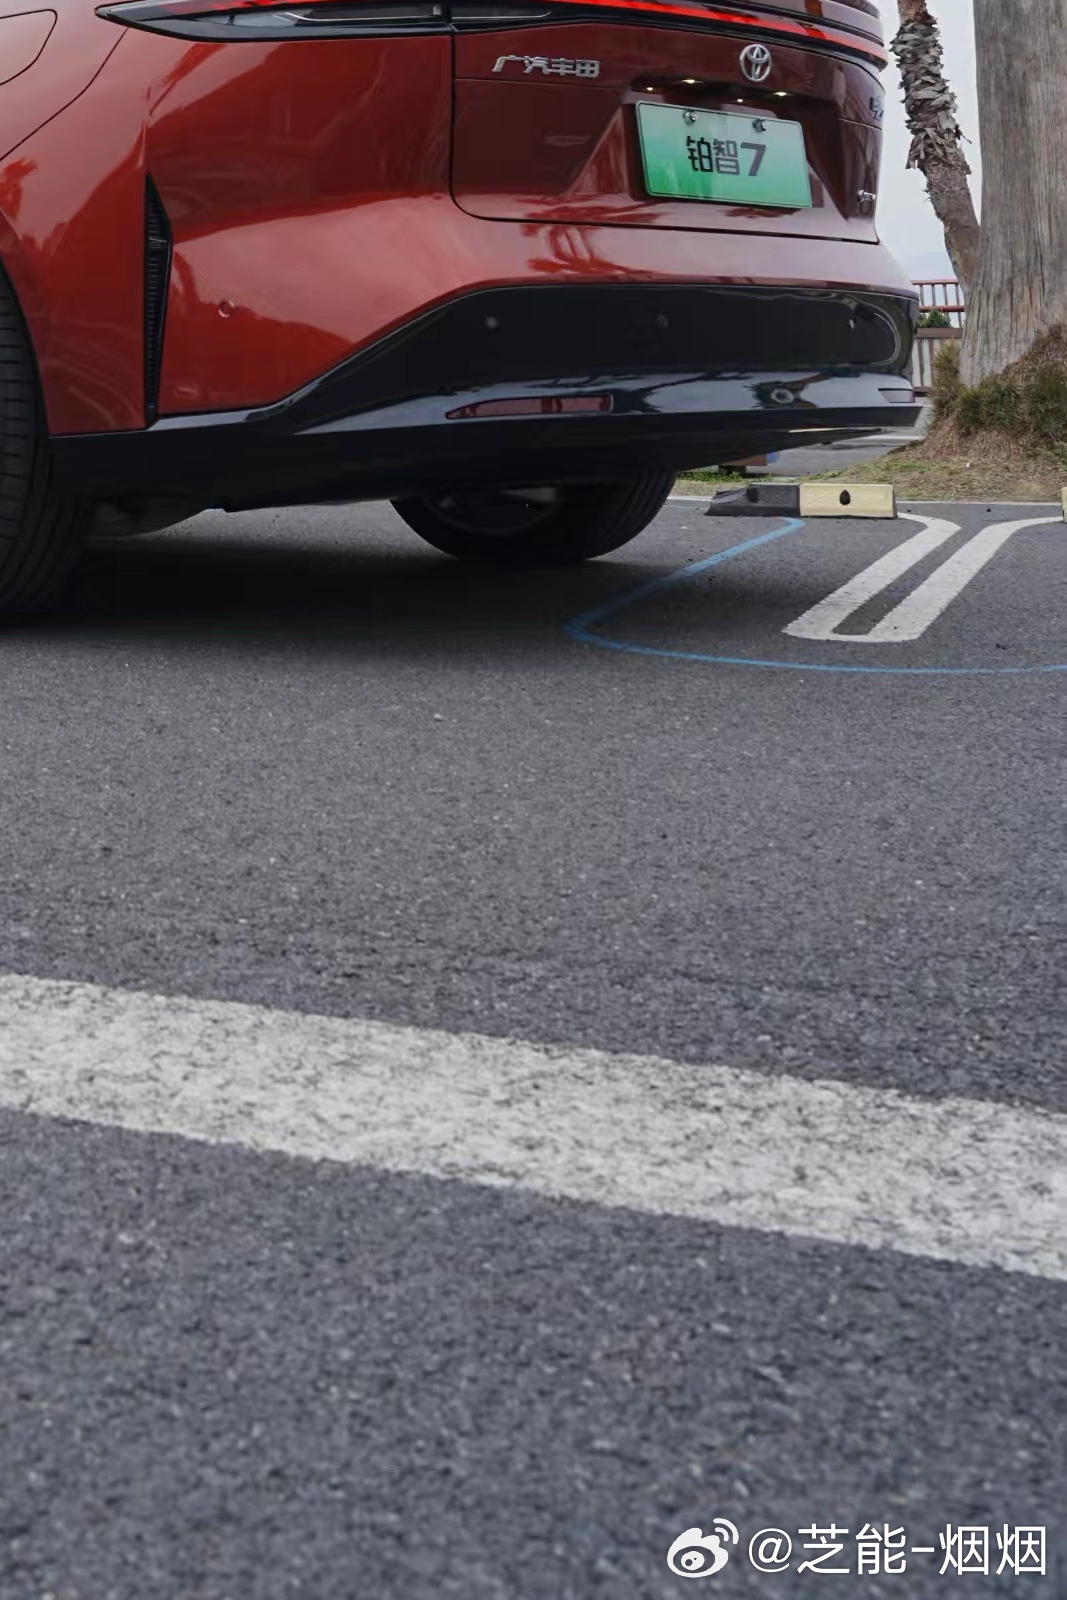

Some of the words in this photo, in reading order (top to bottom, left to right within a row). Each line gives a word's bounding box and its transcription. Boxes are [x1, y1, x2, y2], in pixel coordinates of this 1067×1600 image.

[492, 54, 600, 78] 广汽丰田
[686, 135, 767, 177] 铂智7
